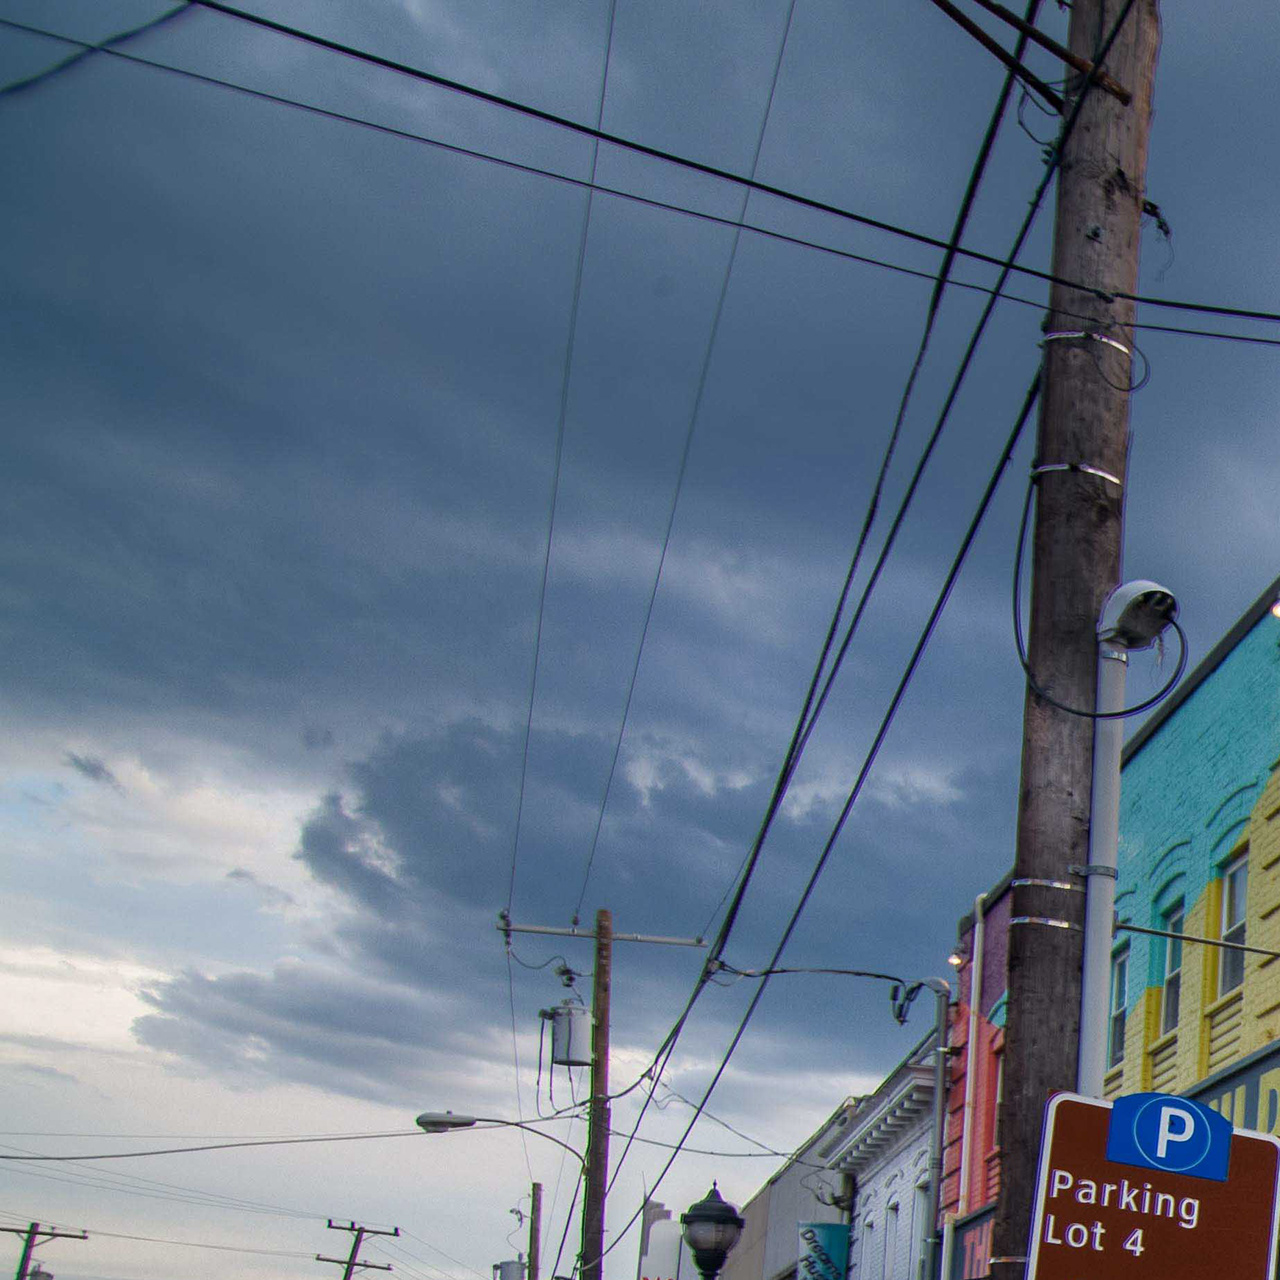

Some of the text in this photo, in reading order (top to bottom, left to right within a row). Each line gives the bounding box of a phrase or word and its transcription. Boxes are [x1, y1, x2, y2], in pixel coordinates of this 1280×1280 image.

[1156, 1106, 1196, 1158] P
[1050, 1169, 1200, 1229] Parking
[1044, 1214, 1145, 1257] Lot 4
